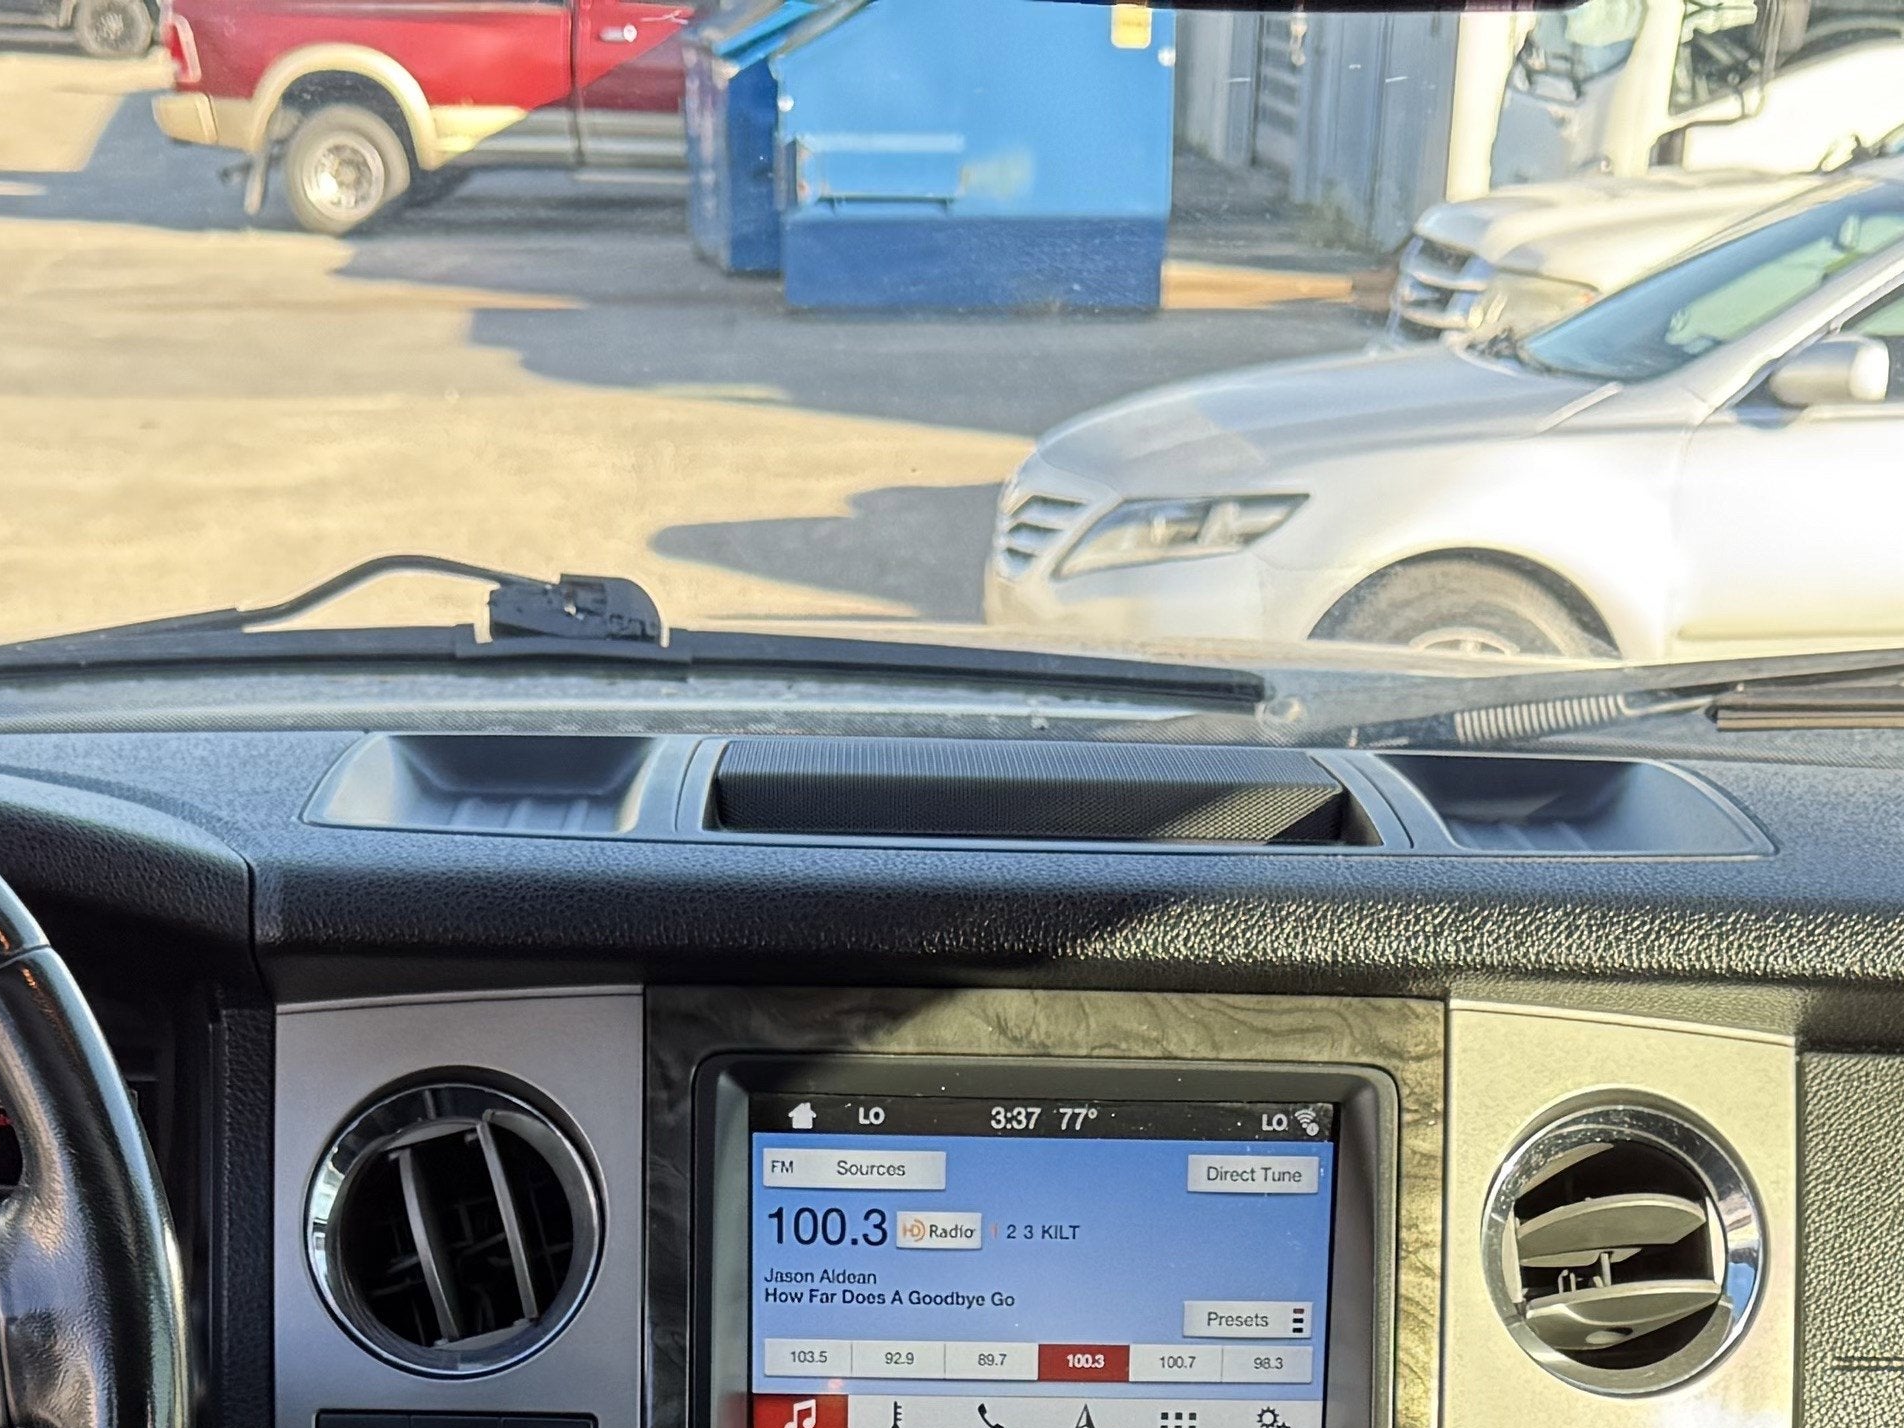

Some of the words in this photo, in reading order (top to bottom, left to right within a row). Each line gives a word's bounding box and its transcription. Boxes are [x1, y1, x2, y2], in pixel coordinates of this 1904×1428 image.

[858, 1107, 886, 1125] LO
[990, 1107, 1042, 1130] 3:37
[1261, 1114, 1287, 1131] LO
[770, 1160, 794, 1174] FM
[836, 1160, 906, 1177] Sources
[1207, 1166, 1256, 1182] Direct
[1261, 1167, 1302, 1183] Tune
[767, 1206, 888, 1246] 100.3
[929, 1224, 976, 1239] Radio
[1006, 1225, 1016, 1240] 2
[1023, 1225, 1034, 1240] 3
[1041, 1225, 1080, 1240] KILT
[764, 1267, 814, 1284] Jason
[819, 1268, 877, 1285] Aldean
[764, 1288, 804, 1304] How
[809, 1288, 837, 1305] Far
[842, 1290, 885, 1305] Does
[891, 1290, 904, 1305] A
[908, 1290, 985, 1309] Goodbye
[990, 1292, 1015, 1307] Go
[1206, 1312, 1269, 1328] Presets
[790, 1350, 828, 1363] 103.5
[884, 1351, 914, 1365] 92.9
[978, 1353, 1007, 1366] 89.7
[1066, 1354, 1105, 1369] 100.3
[1159, 1356, 1197, 1369] 100.7
[1253, 1357, 1284, 1370] 98.3
